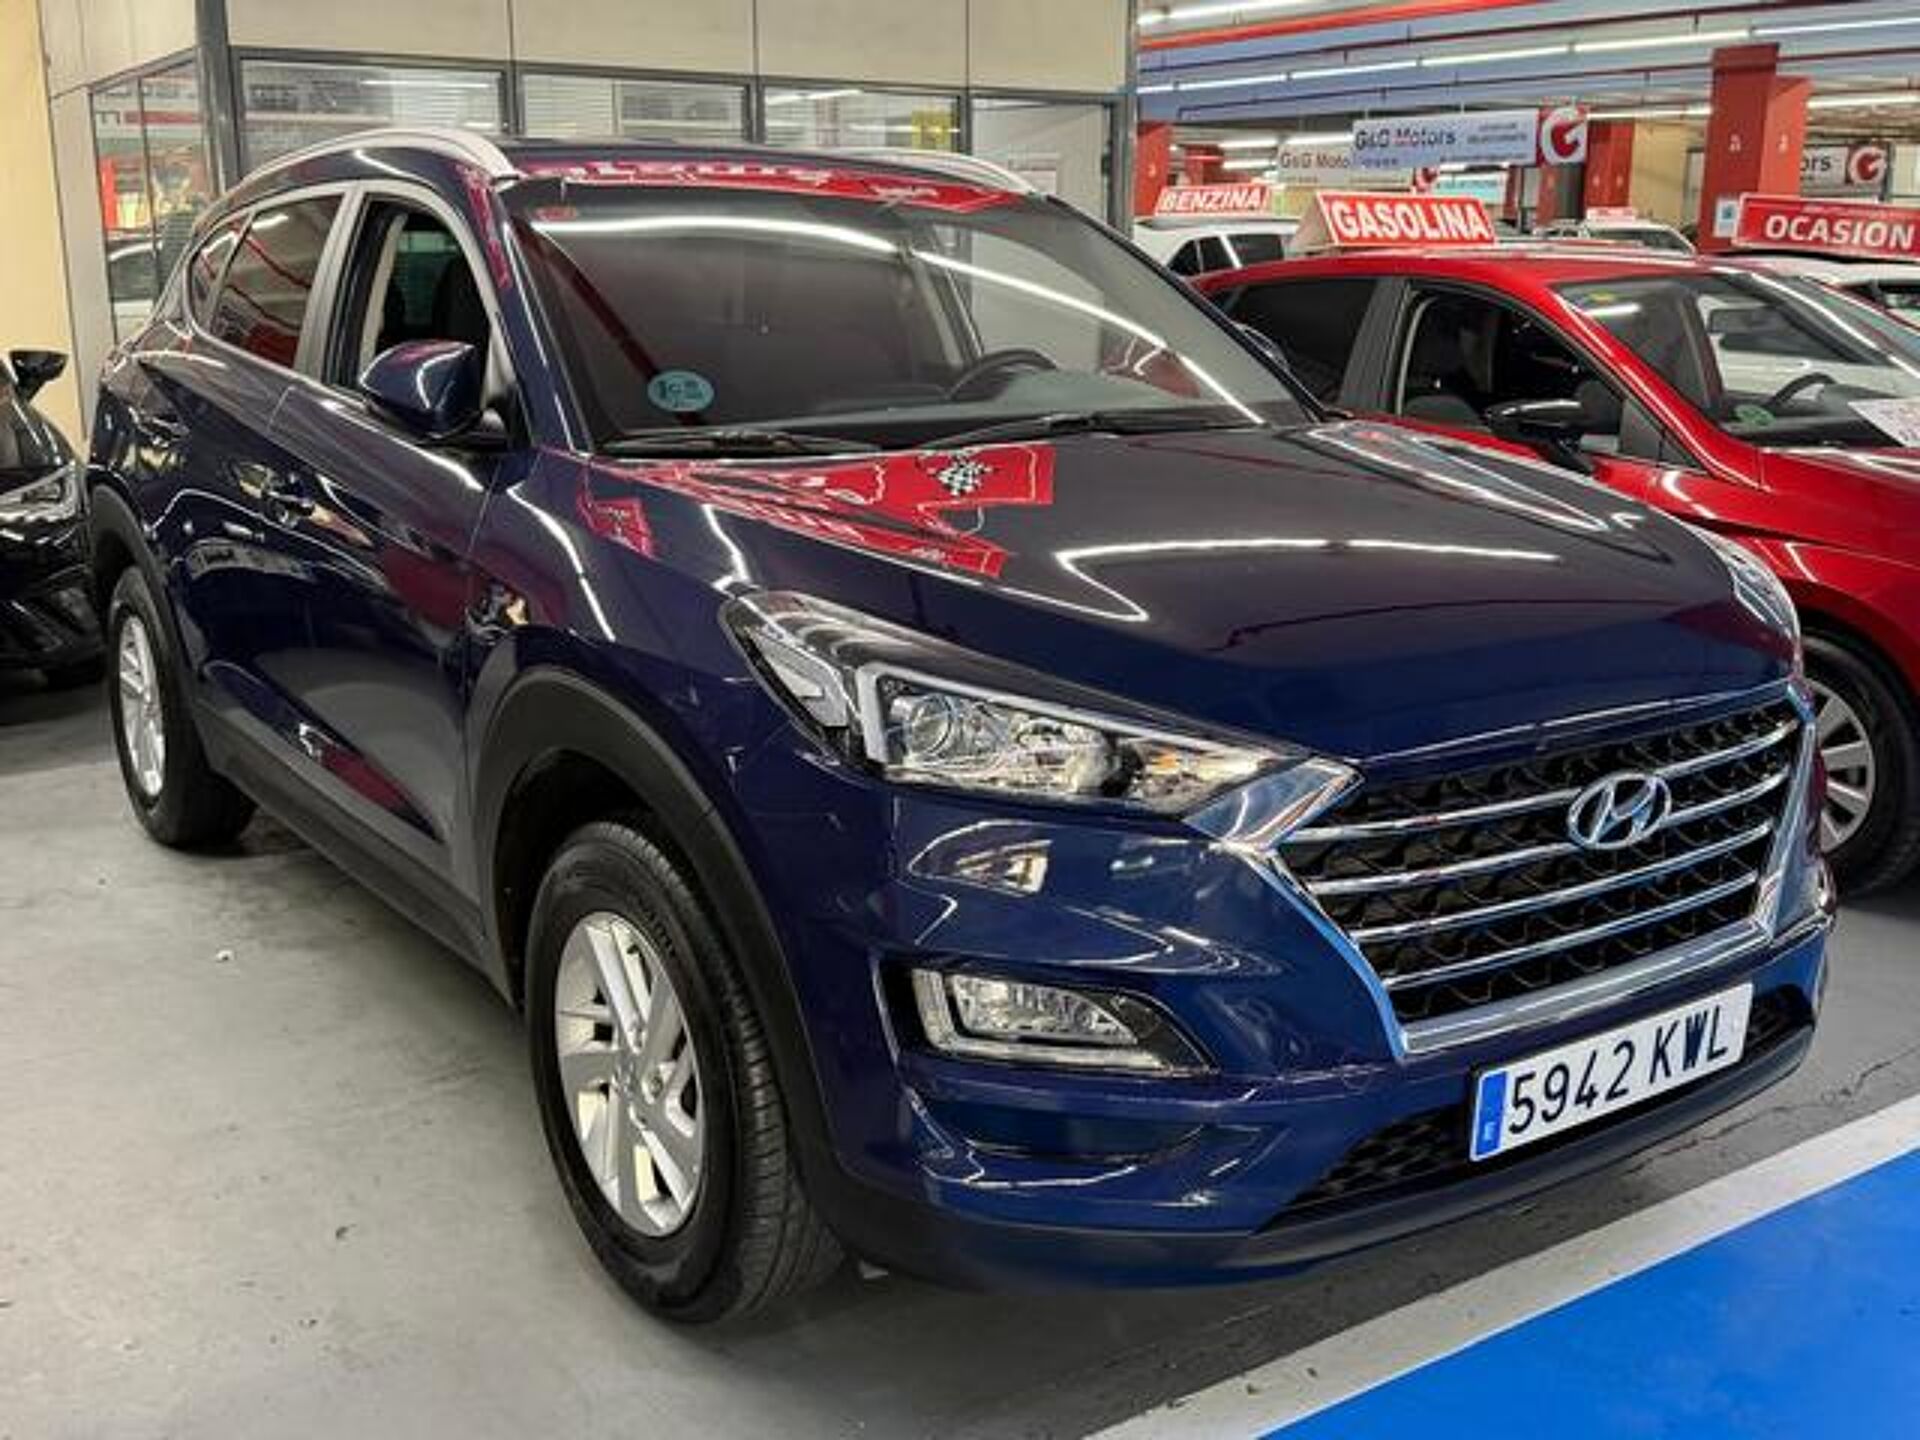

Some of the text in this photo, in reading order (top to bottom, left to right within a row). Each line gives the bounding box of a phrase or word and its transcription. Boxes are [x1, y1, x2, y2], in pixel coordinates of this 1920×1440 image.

[1396, 126, 1456, 148] Motors
[1316, 152, 1352, 169] Moto
[1800, 155, 1832, 173] ors
[1331, 201, 1490, 241] GASOLINA
[1765, 214, 1916, 250] OCASION
[1508, 1004, 1728, 1135] 5942 KWL
